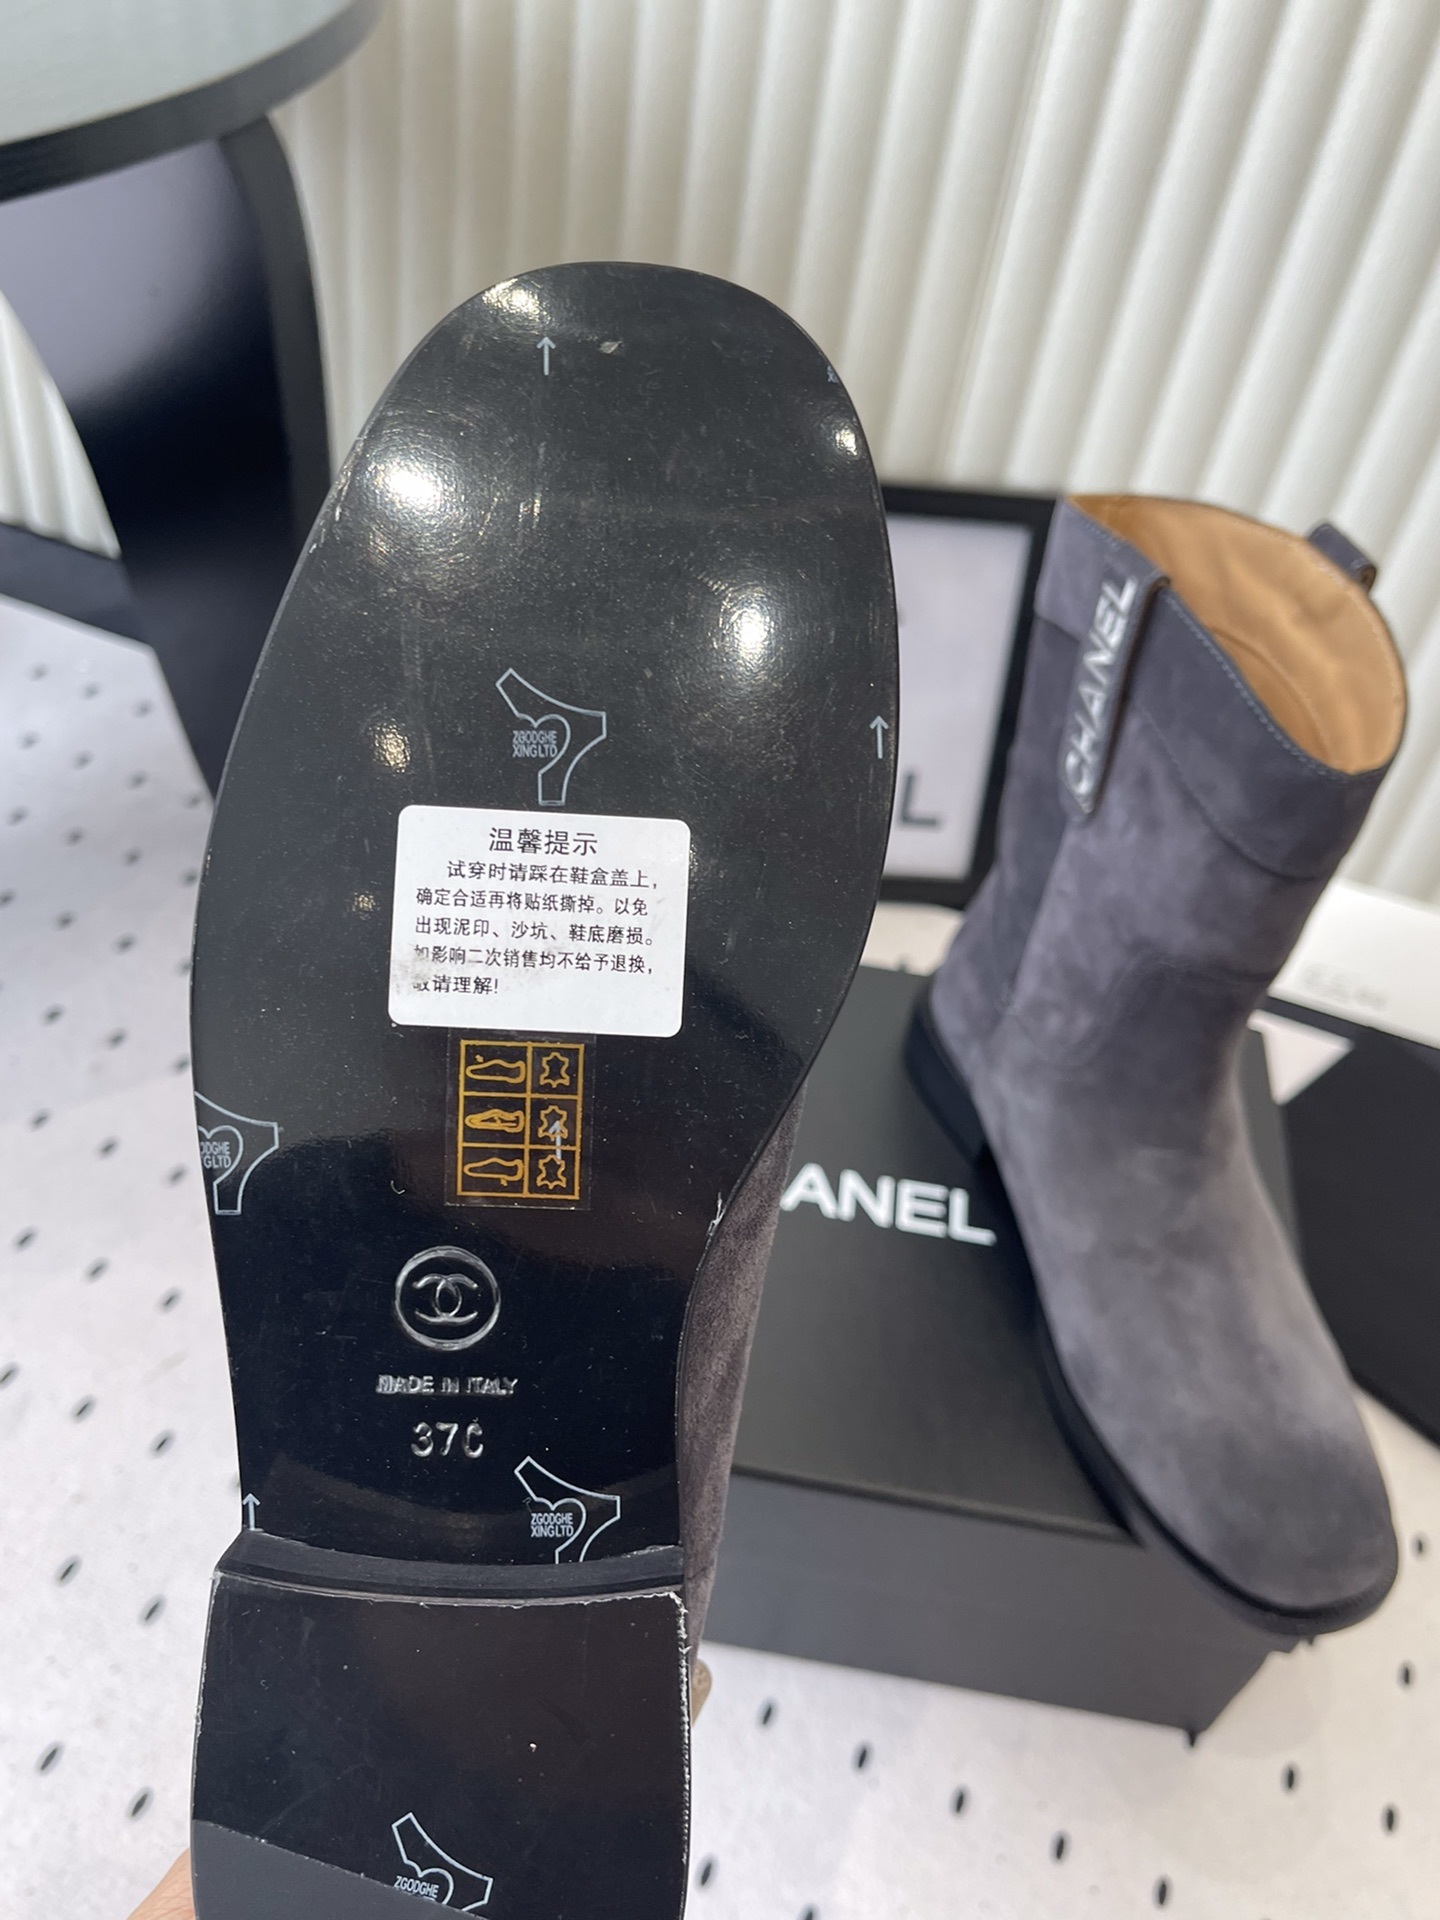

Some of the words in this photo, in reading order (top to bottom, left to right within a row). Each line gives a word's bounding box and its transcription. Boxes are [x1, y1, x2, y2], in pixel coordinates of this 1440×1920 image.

[1065, 575, 1137, 797] CHANEL
[489, 827, 598, 855] 温馨提示
[446, 860, 658, 889] 试穿时请踩在鞋盒盖上，
[415, 916, 653, 946] 出现泥印、沙坑、鞋底磨损。
[779, 1162, 997, 1247] ANEL
[376, 1374, 434, 1394] MADE
[441, 1376, 460, 1393] IN
[466, 1376, 518, 1395] ITALY
[411, 1421, 484, 1458] 37C
